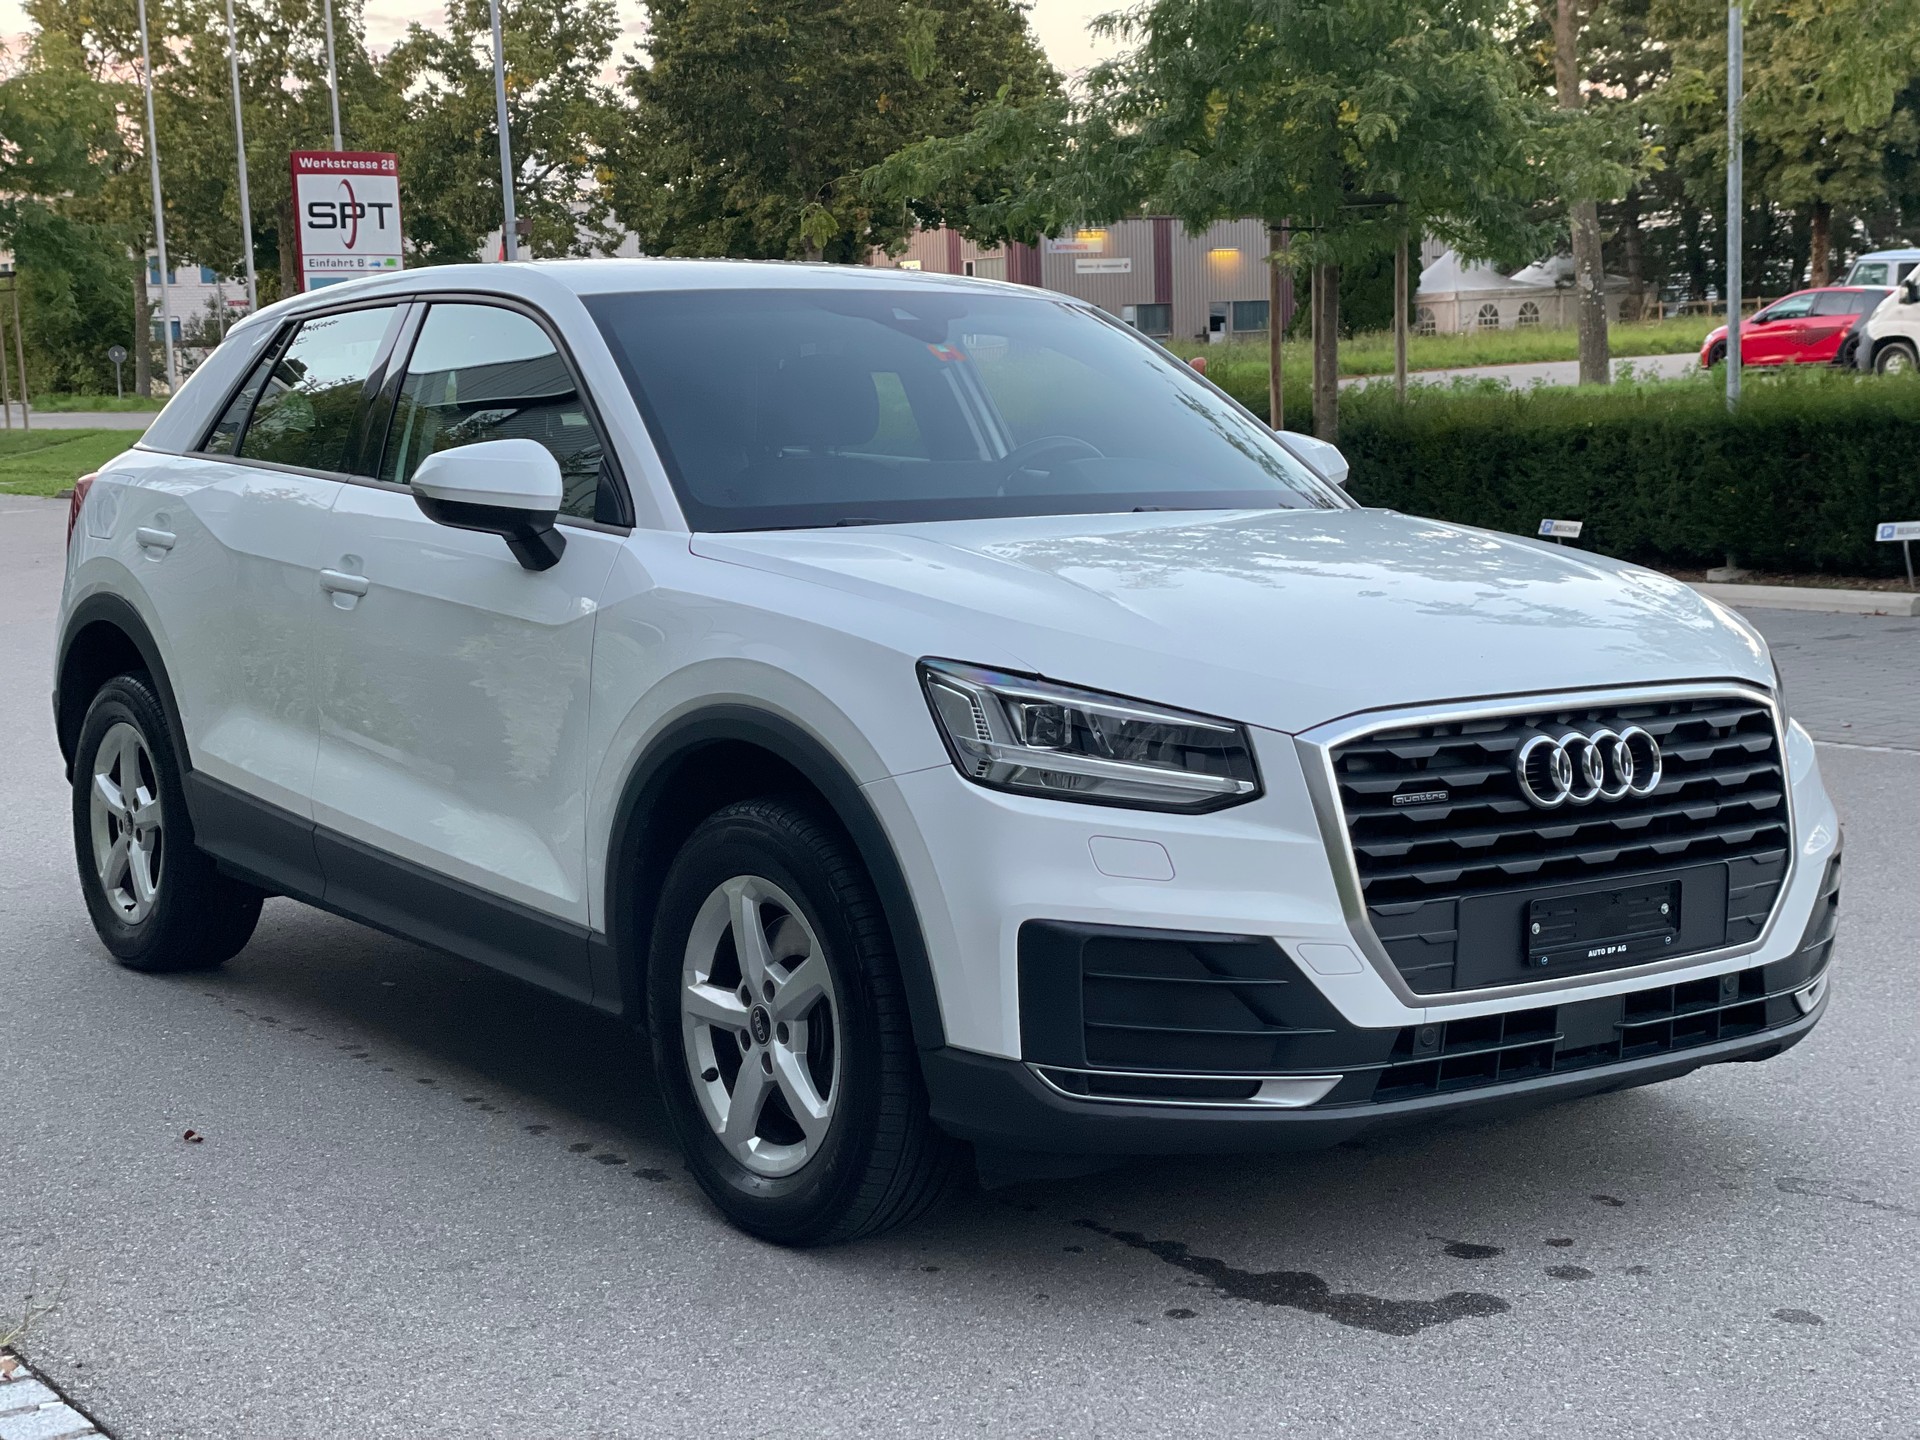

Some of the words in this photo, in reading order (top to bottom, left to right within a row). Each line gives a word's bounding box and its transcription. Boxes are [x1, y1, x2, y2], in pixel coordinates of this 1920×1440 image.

[299, 157, 378, 169] Werkstrasse
[381, 159, 395, 170] 28
[307, 201, 393, 230] SPT
[309, 258, 354, 268] Einfahrt
[1395, 792, 1447, 804] quattro
[1588, 947, 1606, 957] AUTO
[1617, 944, 1627, 952] AG
